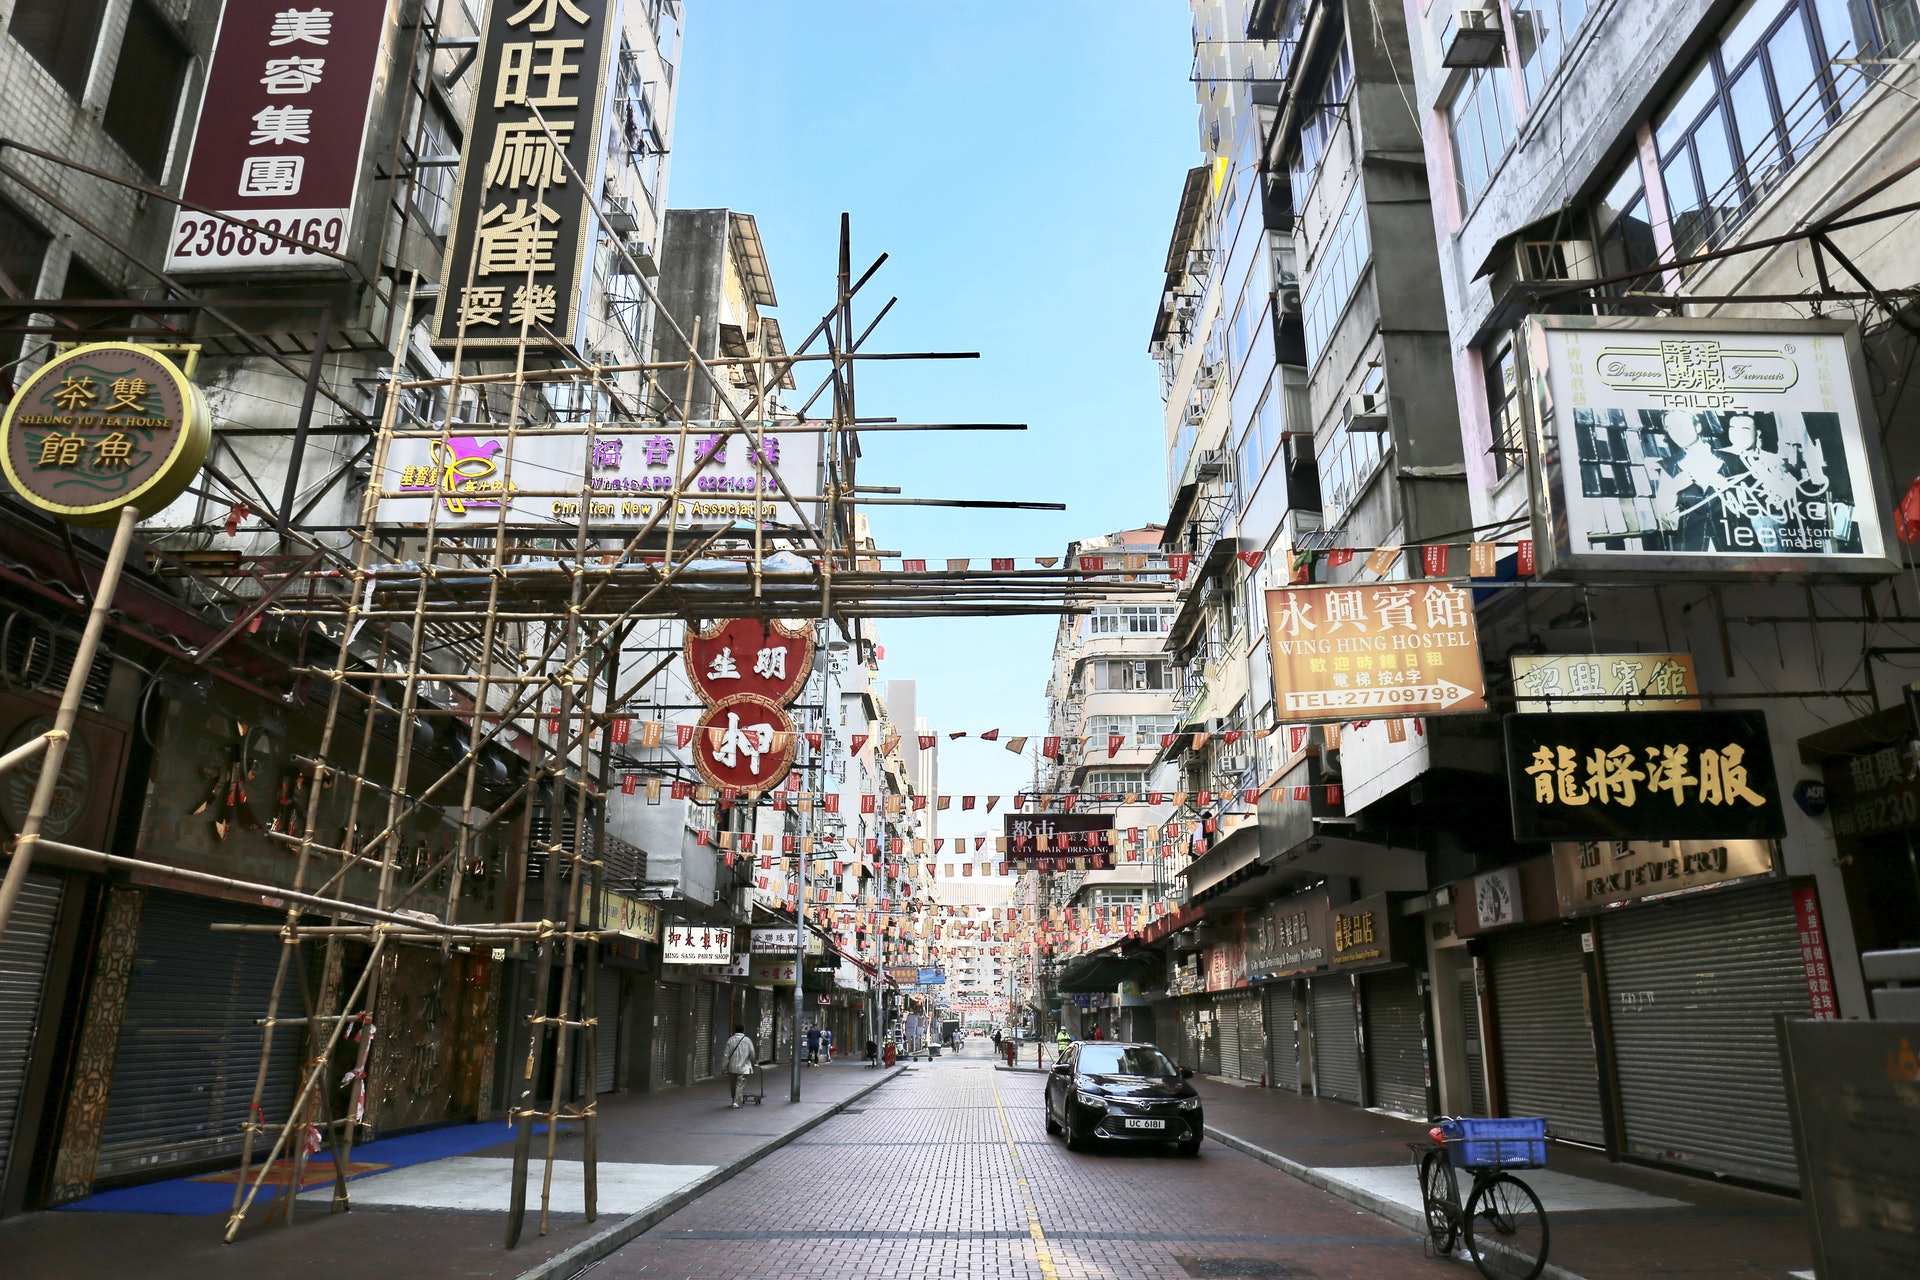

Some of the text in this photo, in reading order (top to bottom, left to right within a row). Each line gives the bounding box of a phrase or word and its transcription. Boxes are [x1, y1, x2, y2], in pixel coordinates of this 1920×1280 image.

[237, 6, 334, 197] 美容集團
[173, 214, 345, 260] 23683469
[457, 282, 558, 328] 耍樂
[18, 415, 172, 429] SHEUNG YU TEA HOUSE
[552, 500, 778, 517] Chritian New Le Associaton
[1720, 519, 1777, 547] lee
[1778, 526, 1835, 538] custom
[1780, 537, 1823, 549] made
[1273, 584, 1468, 637] 永興賓館
[1277, 631, 1470, 656] WING HING HOSTEL
[1289, 686, 1460, 708] TEL:27709798
[713, 712, 773, 775] 押
[1524, 743, 1766, 807] 龍將洋服
[1805, 786, 1824, 798] ADT
[1012, 819, 1056, 842] 都市
[1129, 1119, 1161, 1128] UC 6181
